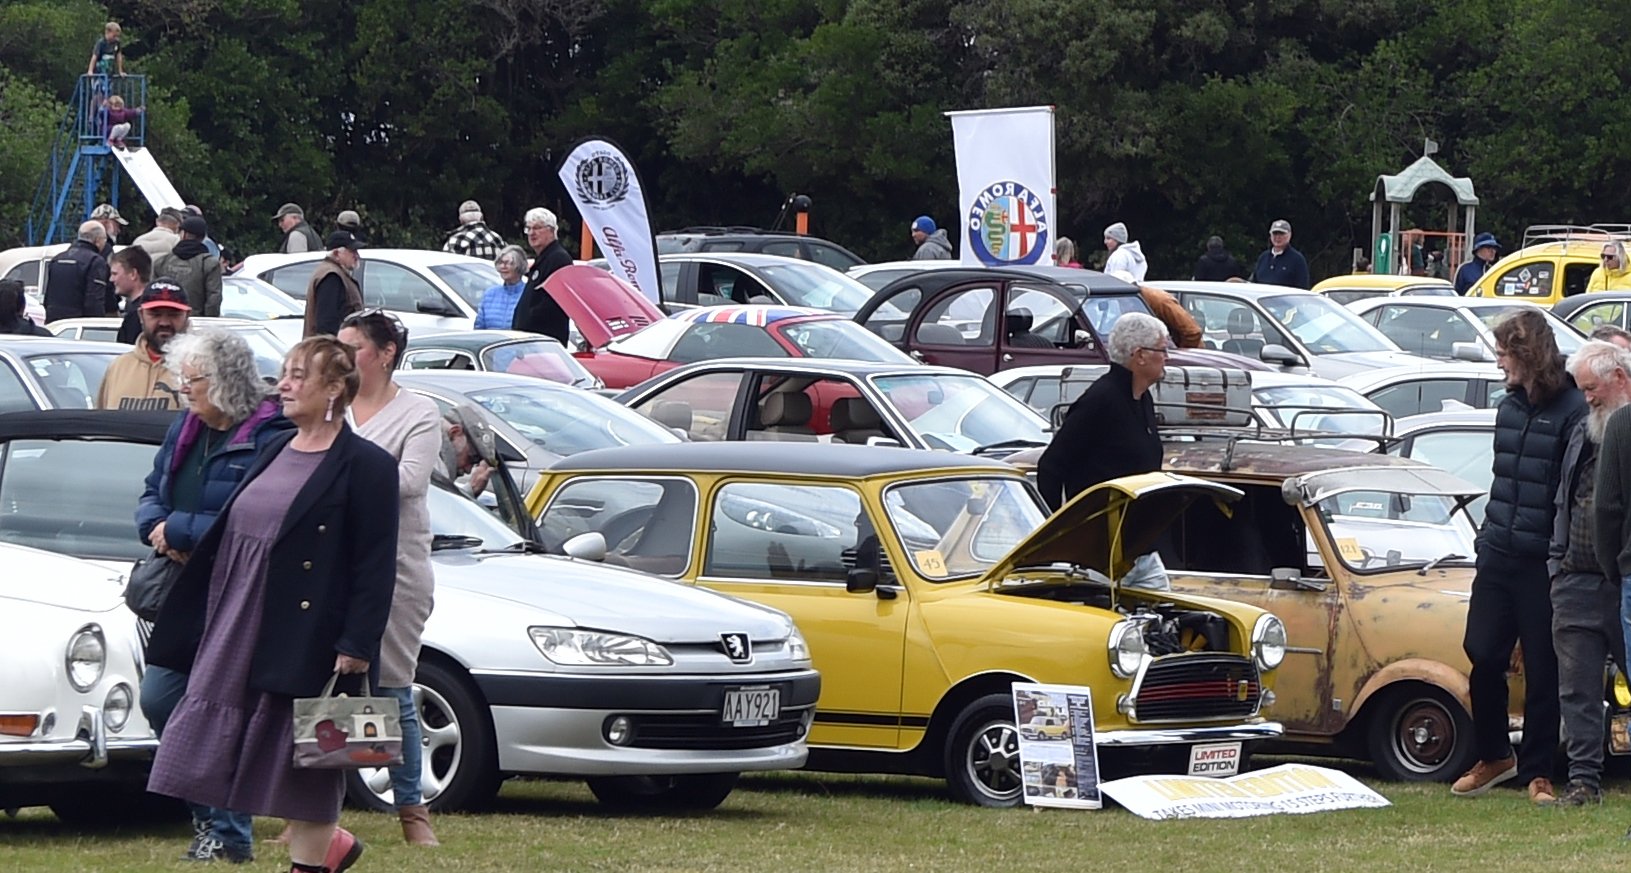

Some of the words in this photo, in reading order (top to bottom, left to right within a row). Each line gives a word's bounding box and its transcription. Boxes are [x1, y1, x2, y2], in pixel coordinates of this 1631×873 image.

[924, 558, 940, 570] 45
[1195, 748, 1237, 760] LIMITED
[1193, 761, 1236, 773] EDITION
[1152, 804, 1196, 819] TAKES
[1194, 802, 1221, 814] MINI
[1294, 793, 1333, 808] STEPS
